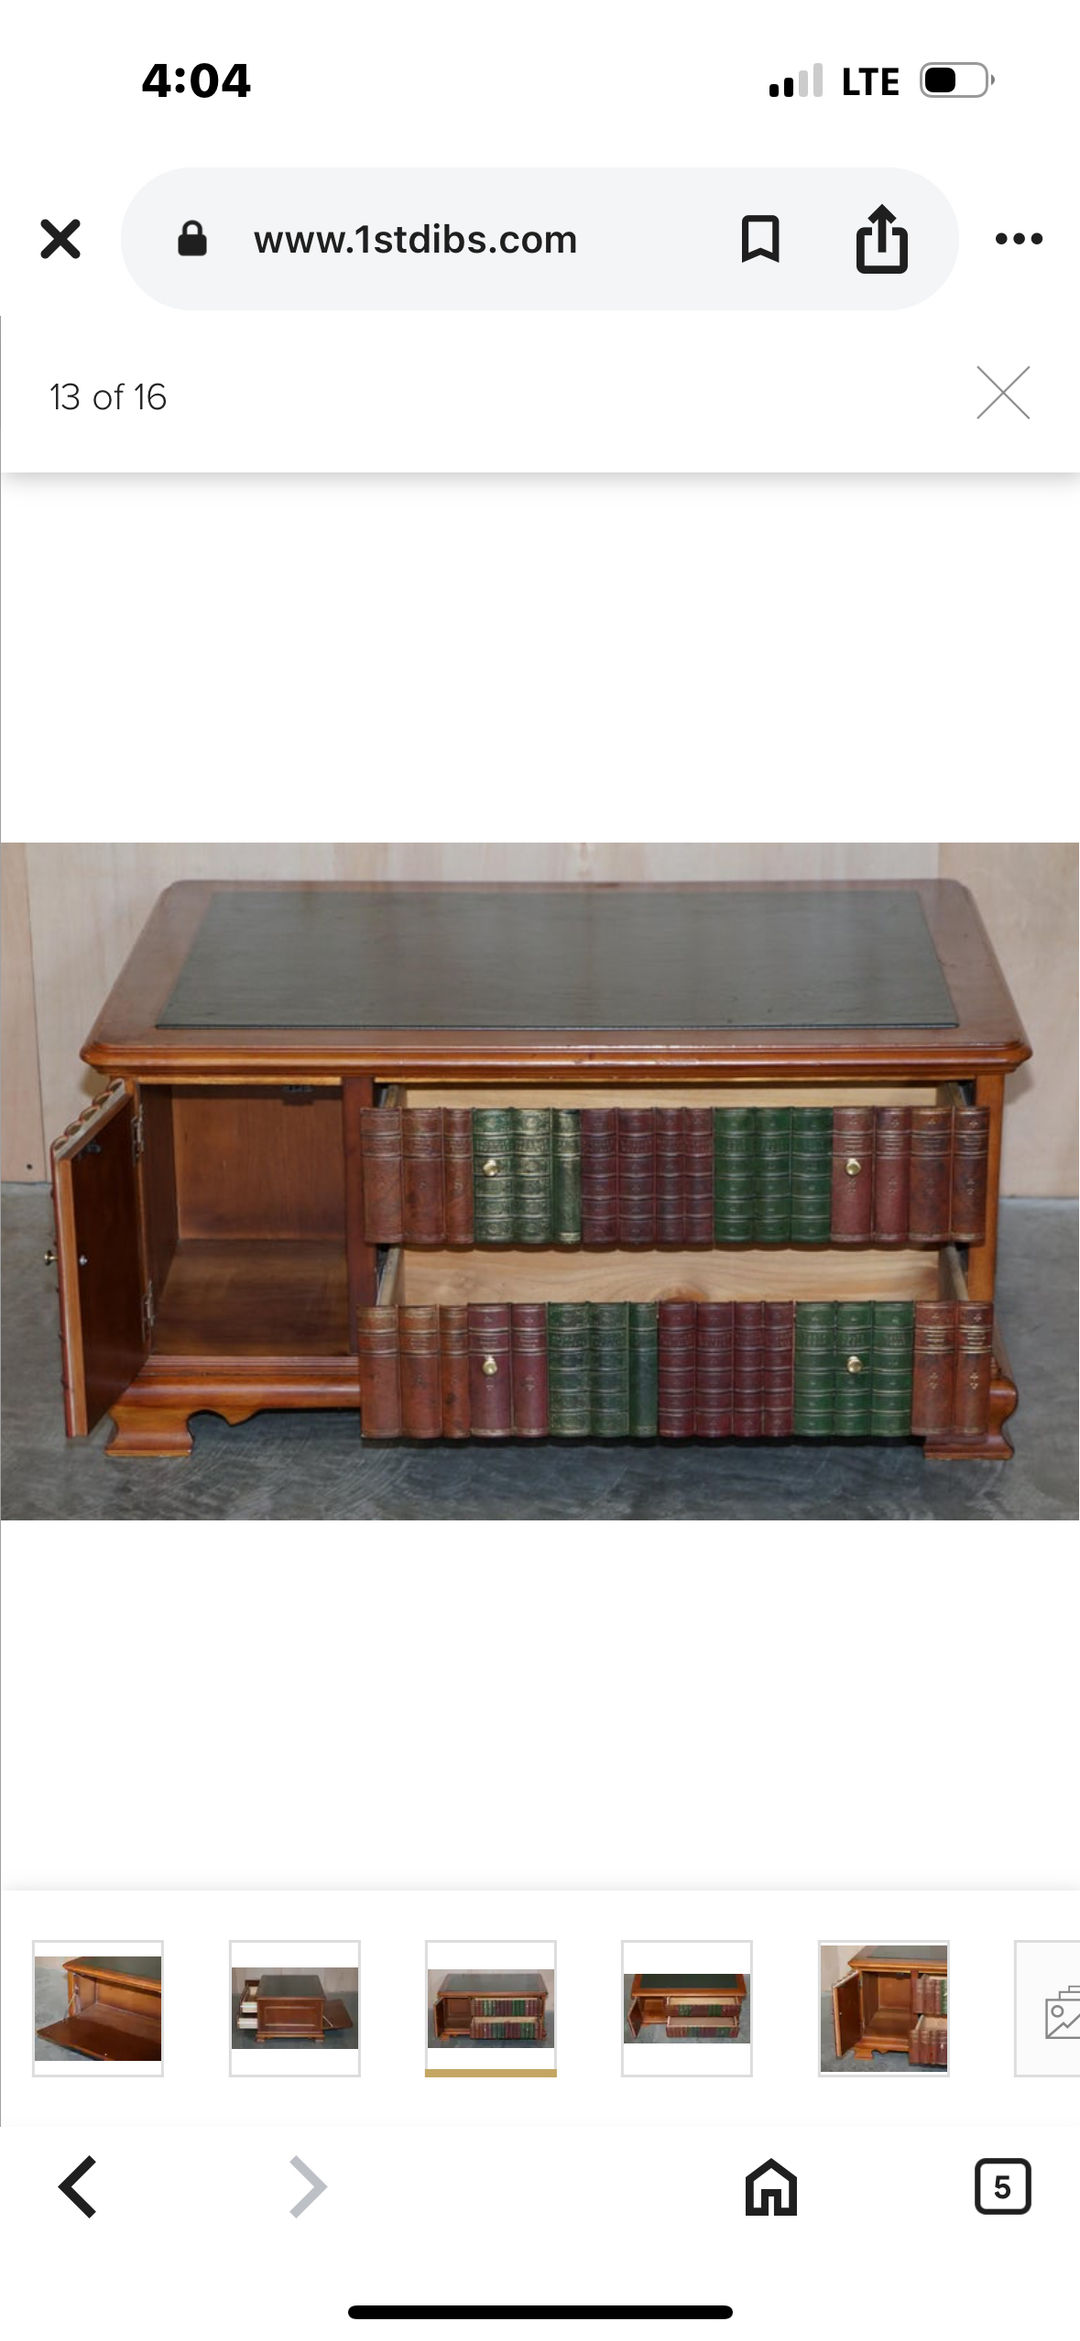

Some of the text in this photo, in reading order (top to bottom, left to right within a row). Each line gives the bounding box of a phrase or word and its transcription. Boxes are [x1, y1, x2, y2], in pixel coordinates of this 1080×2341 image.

[142, 63, 251, 98] 4:04
[843, 68, 899, 95] LTE
[254, 223, 576, 253] www.1stdibs.com
[51, 383, 166, 410] 13 of 16
[995, 2175, 1011, 2199] 5
